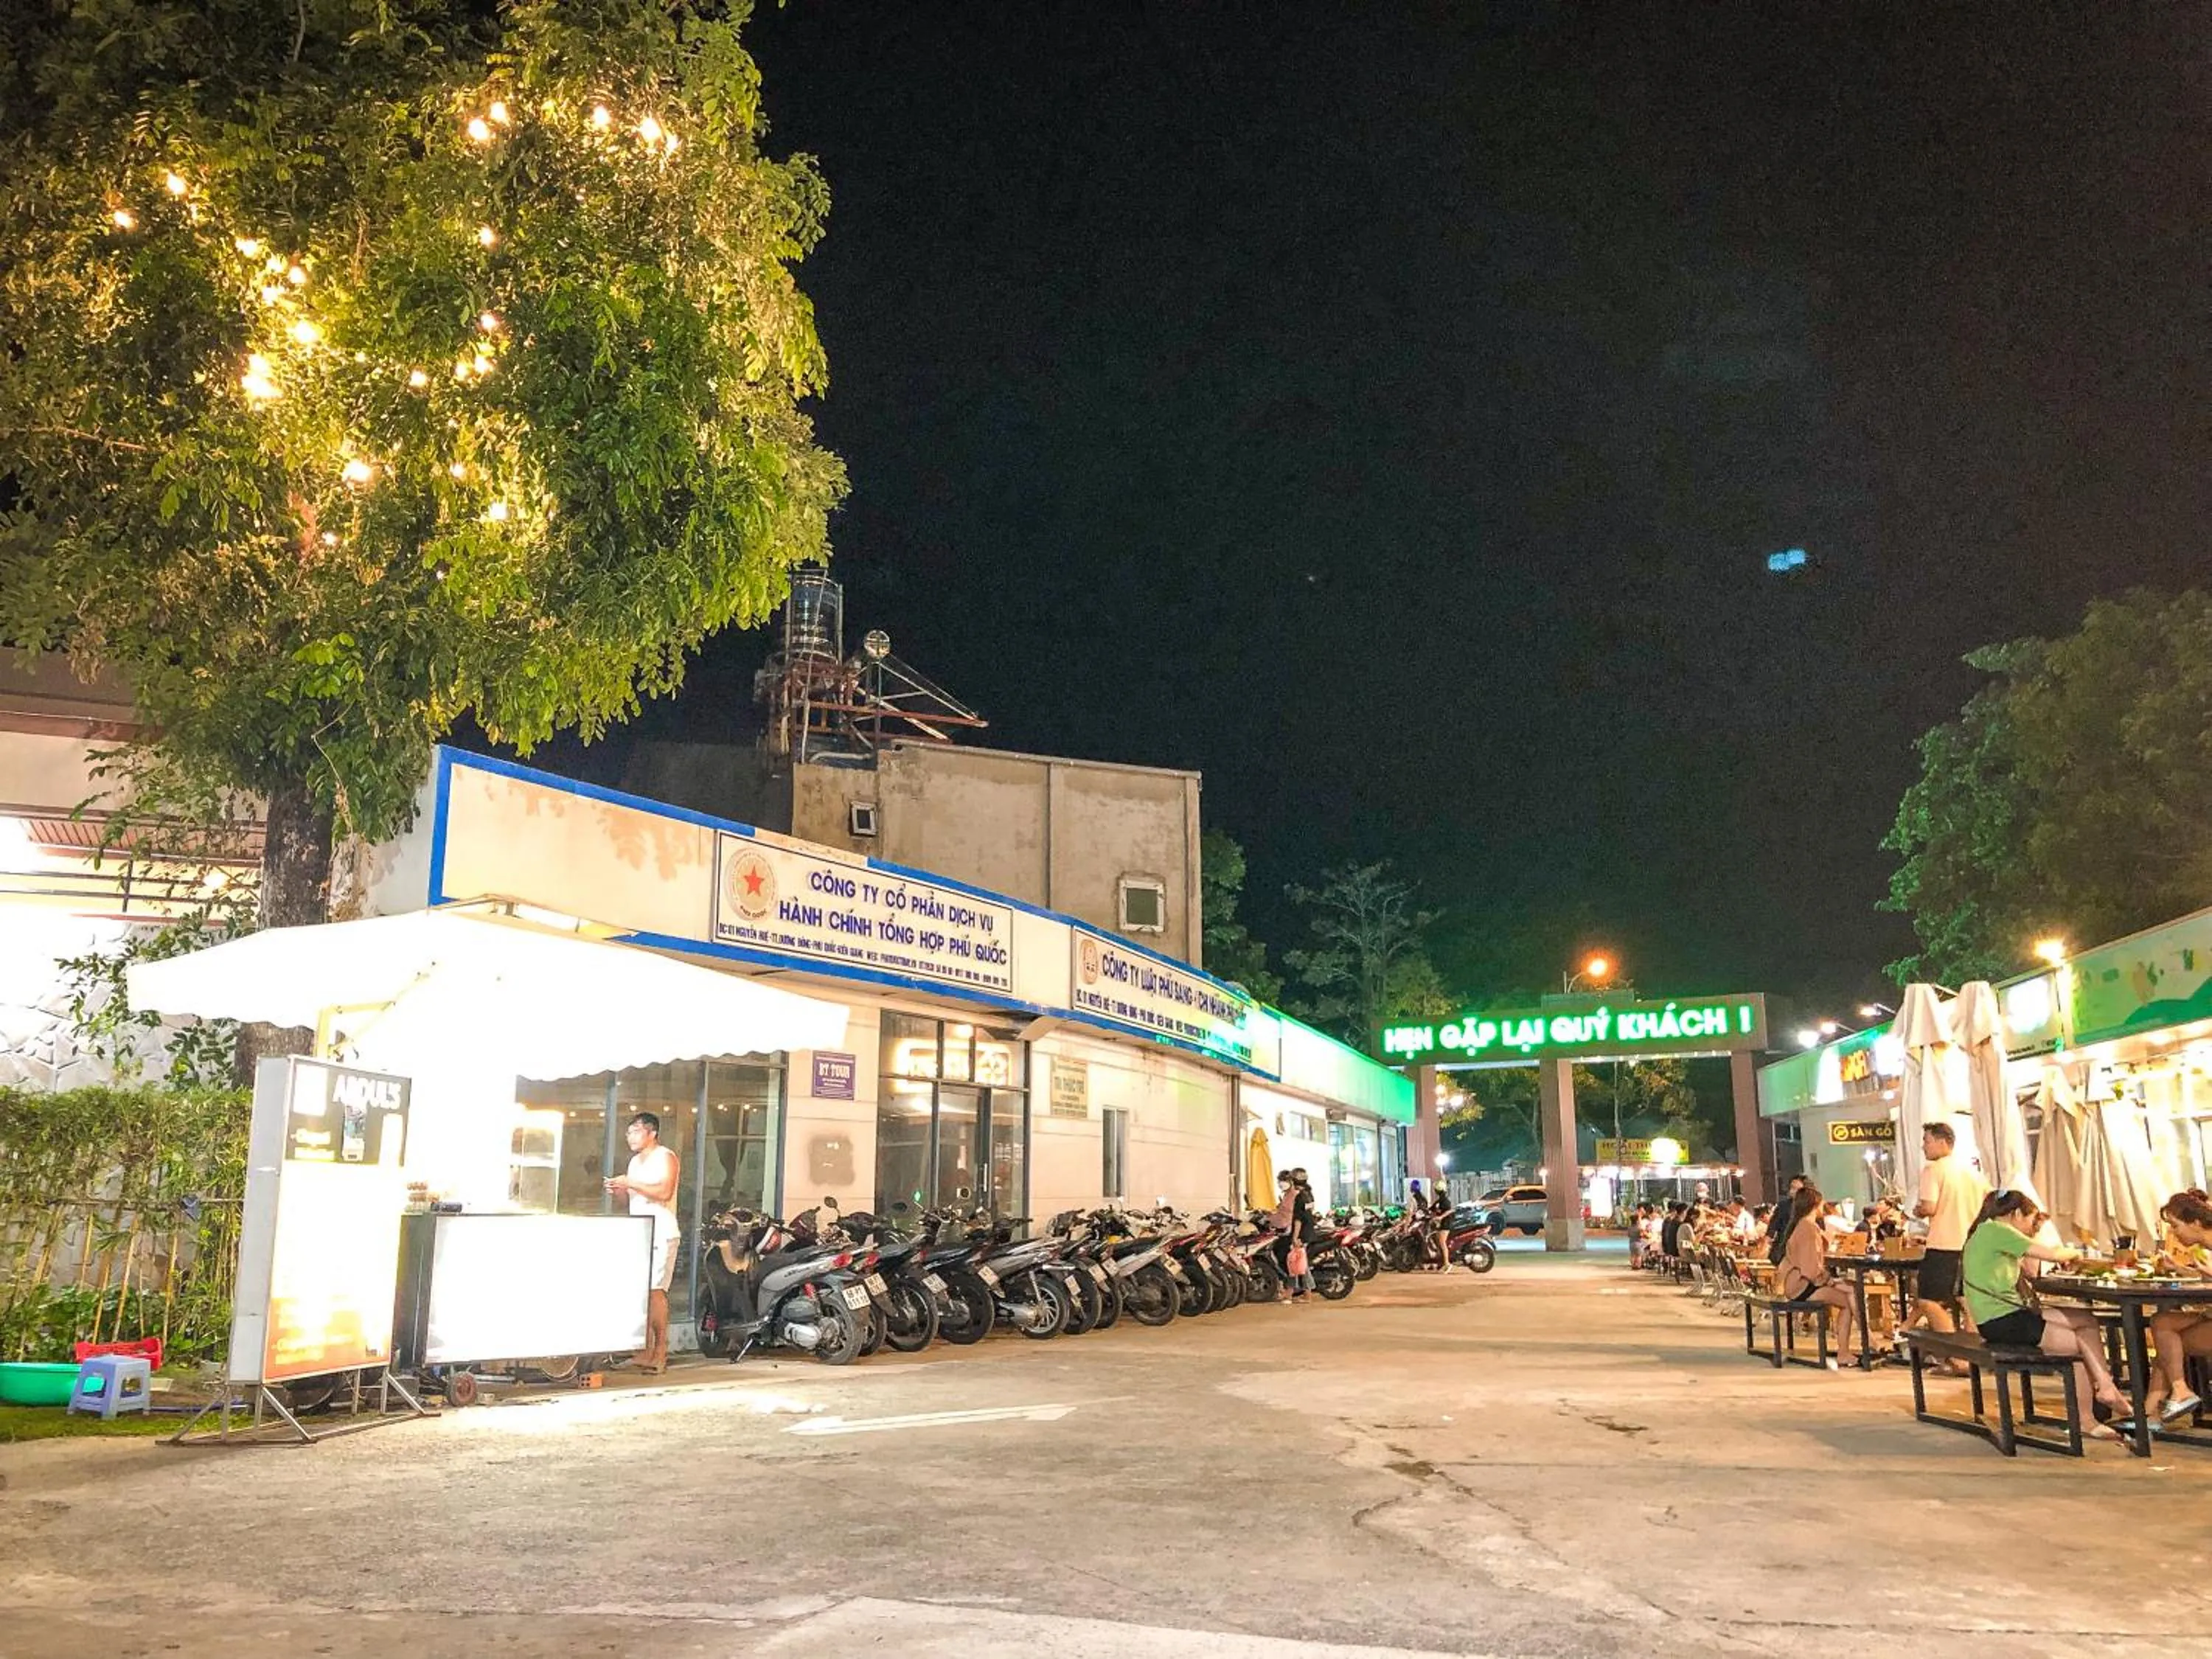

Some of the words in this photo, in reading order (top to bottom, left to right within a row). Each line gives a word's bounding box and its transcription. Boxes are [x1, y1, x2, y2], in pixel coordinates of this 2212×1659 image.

[779, 896, 822, 928] HÀNH
[830, 908, 872, 937] CHÍNH
[879, 912, 914, 945] TỔNG
[919, 930, 944, 954] HỢP
[949, 934, 970, 957] PHÚ
[975, 939, 1007, 965] QUỐC
[810, 869, 856, 898] CÔNG
[863, 884, 879, 904] TY
[886, 883, 906, 909] CỔ
[911, 890, 944, 919] PHẦN
[949, 906, 975, 928] DỊCH
[979, 914, 993, 936] VỤ
[1102, 950, 1127, 982] CÔNG
[1130, 964, 1139, 987] TY
[1141, 967, 1157, 997] LUẬT
[1385, 1026, 1433, 1060] HẸN
[1439, 1017, 1497, 1057] GẶP
[1501, 1018, 1545, 1053] LẠI
[1549, 1006, 1610, 1043] QUÝ
[1617, 1003, 1728, 1040] KHÁCH
